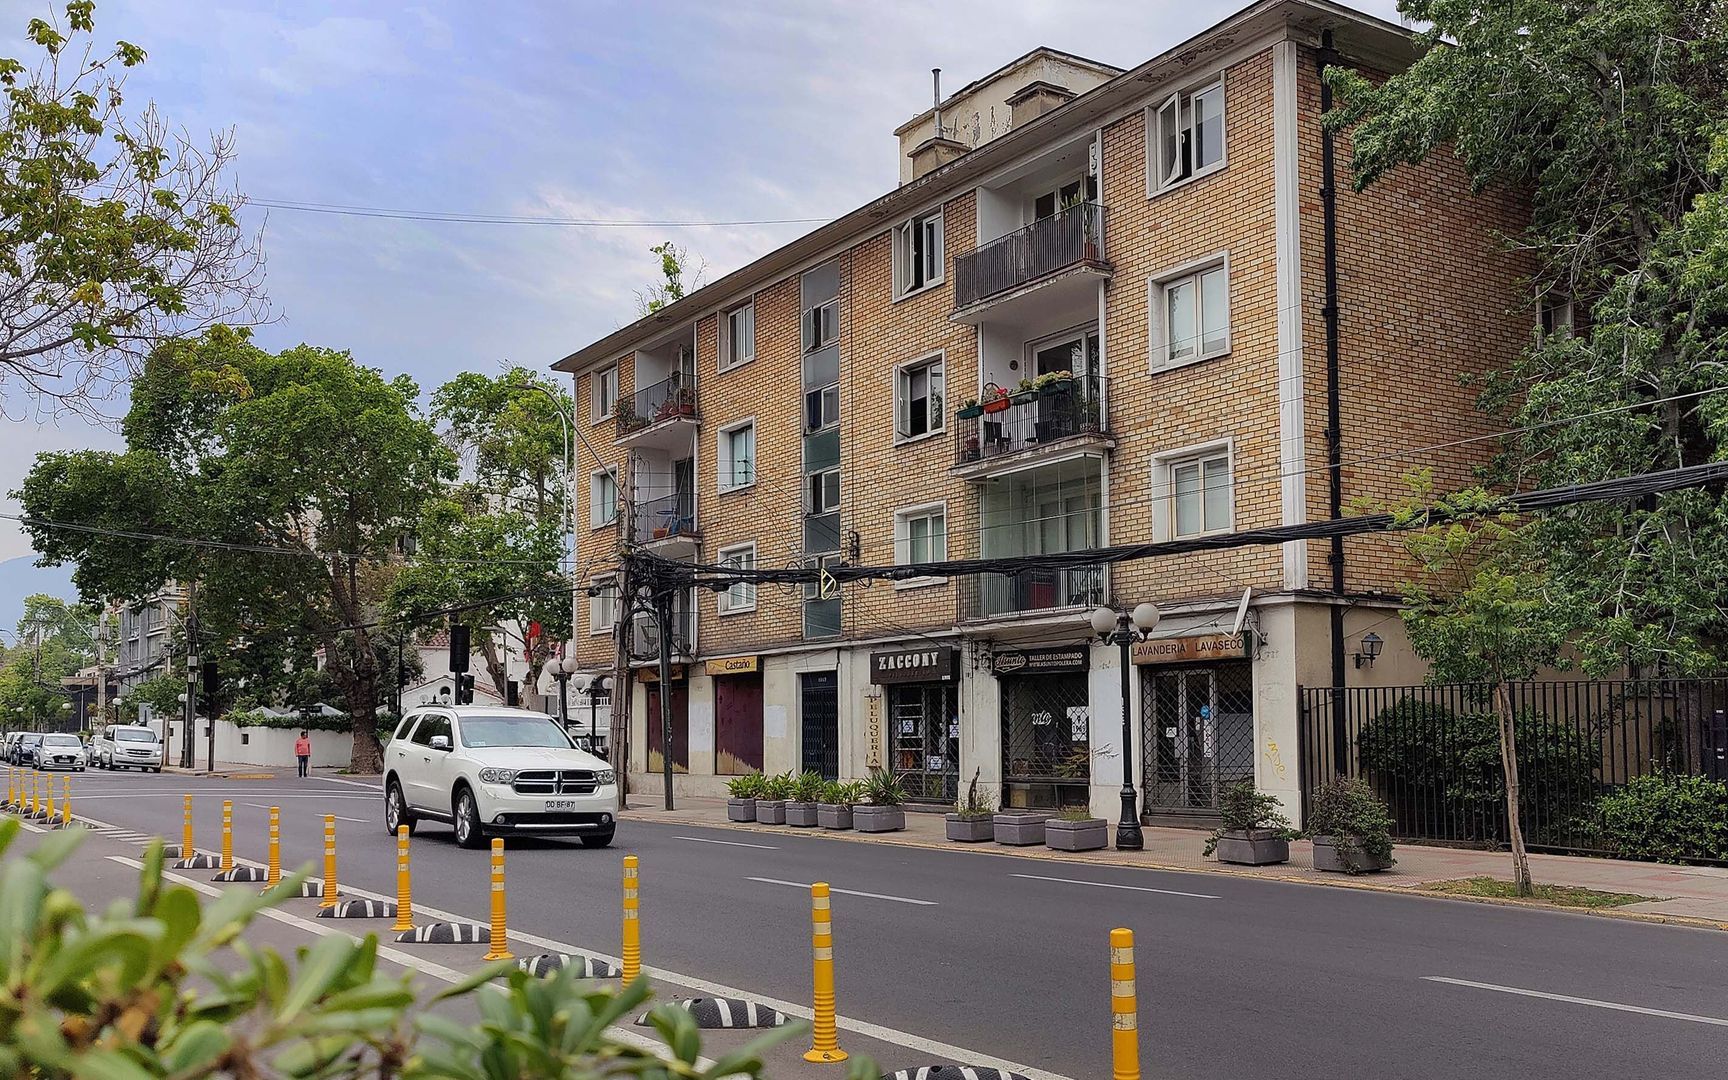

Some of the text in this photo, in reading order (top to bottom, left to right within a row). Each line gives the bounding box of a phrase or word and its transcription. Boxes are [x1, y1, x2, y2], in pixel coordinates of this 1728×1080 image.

[1132, 638, 1244, 657] LAVANDERIA LAVASECO
[725, 659, 750, 670] Castaño
[878, 651, 939, 670] ZACCONY
